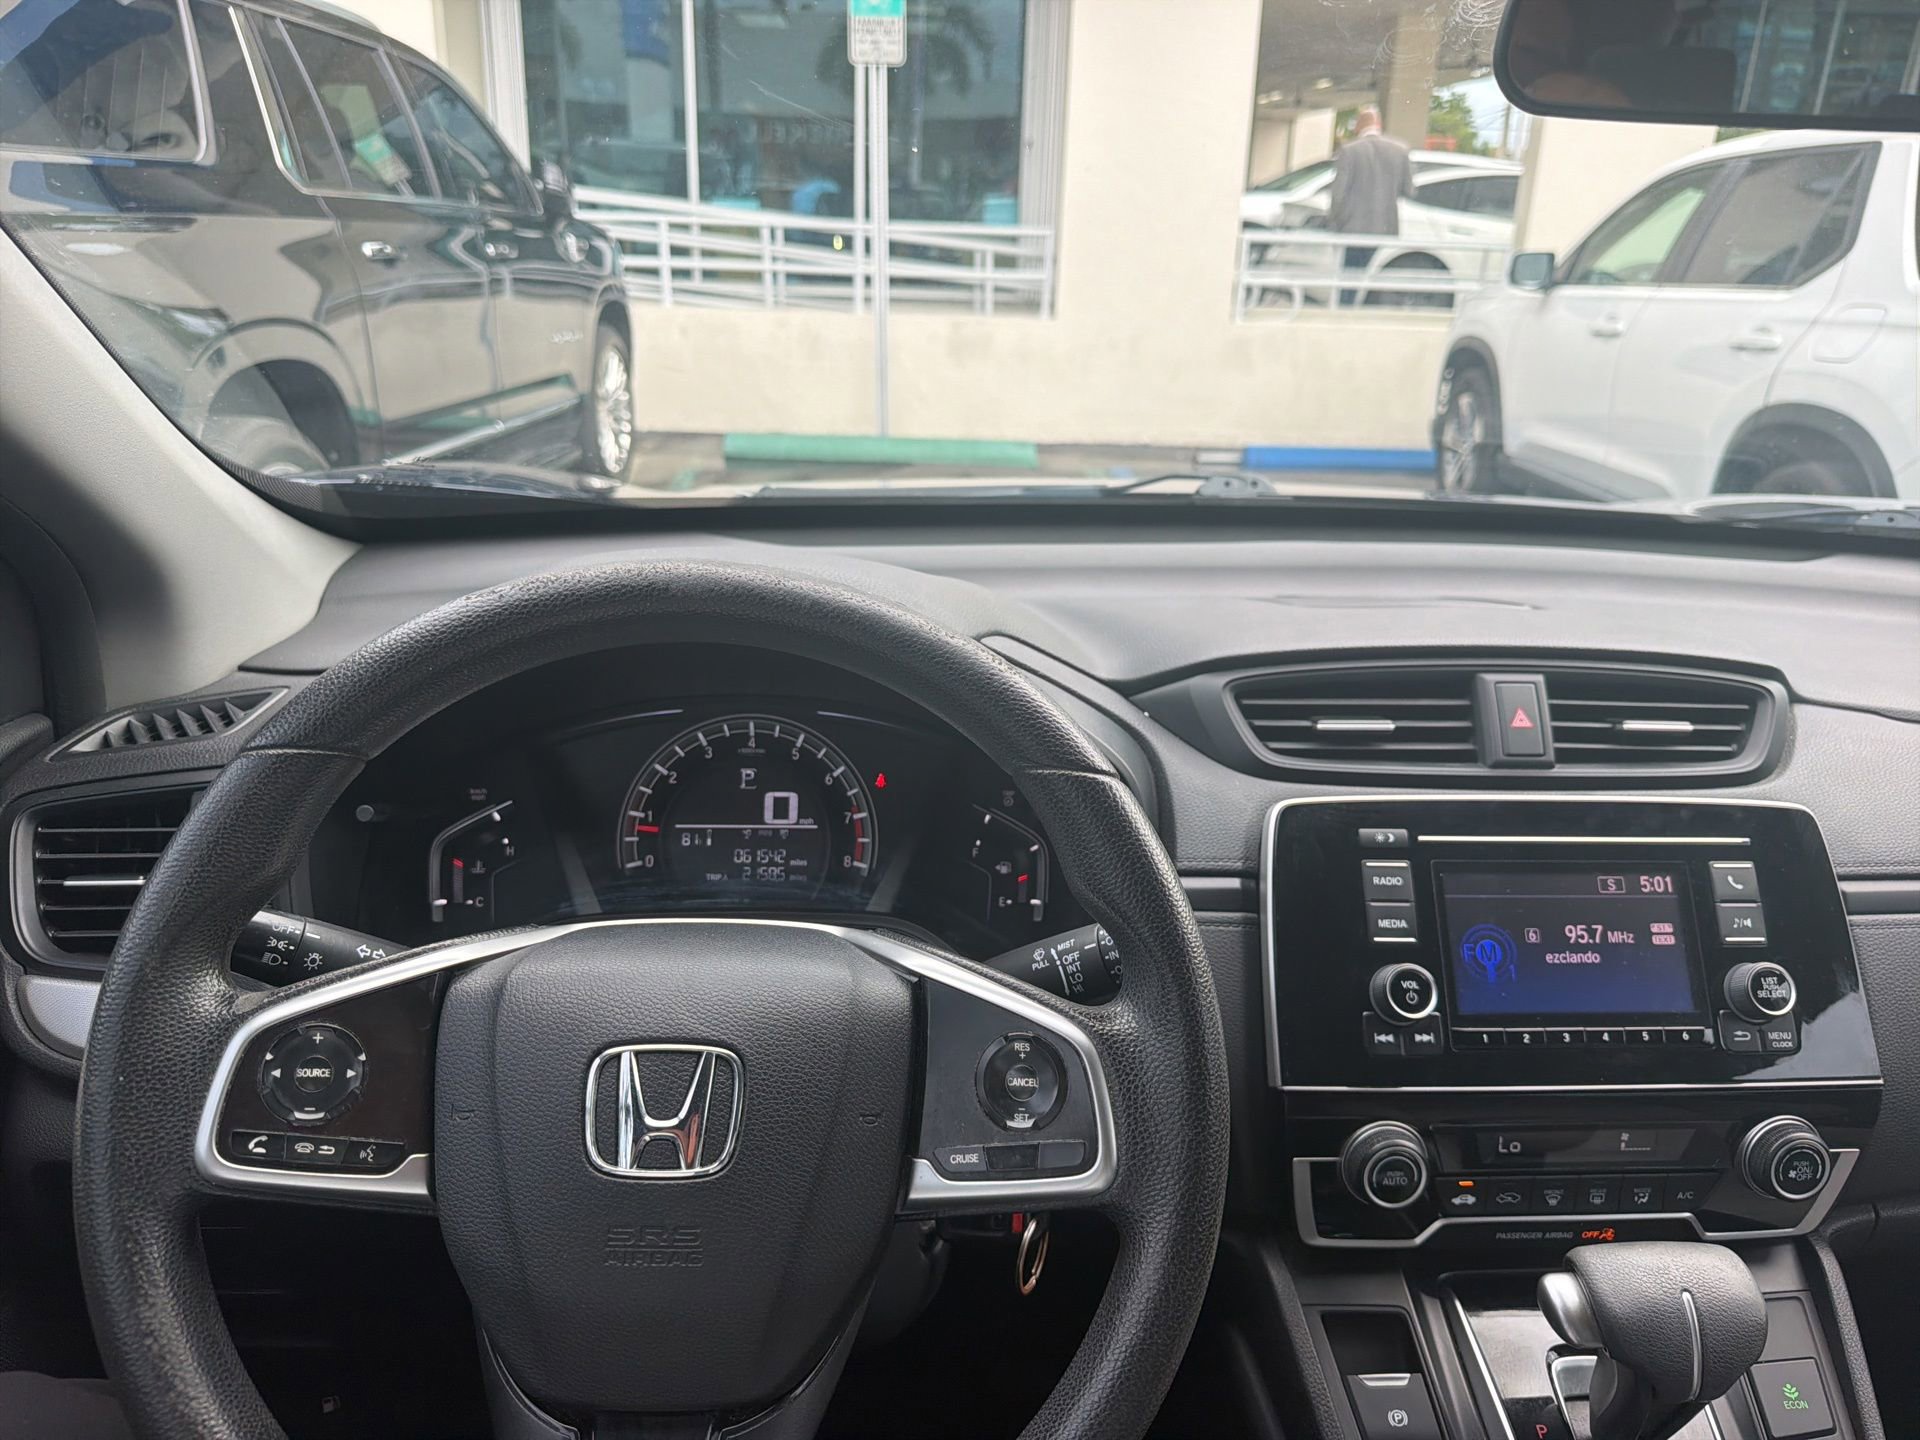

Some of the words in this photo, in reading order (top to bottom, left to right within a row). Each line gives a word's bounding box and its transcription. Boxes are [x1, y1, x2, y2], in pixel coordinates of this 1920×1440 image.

[748, 737, 756, 748] 4
[704, 747, 713, 759] 3
[791, 748, 800, 760] 5
[669, 772, 677, 784] 2
[824, 773, 833, 785] 6
[764, 792, 799, 824] 0
[647, 810, 653, 822] 1
[844, 812, 852, 824] 7
[506, 846, 515, 856] H
[972, 847, 979, 858] F
[645, 855, 654, 867] 0
[843, 856, 852, 867] 8
[1373, 876, 1402, 886] RADIO
[1607, 879, 1616, 889] S
[1640, 876, 1673, 893] 5:01
[475, 896, 484, 907] C
[999, 896, 1006, 907] E
[1378, 918, 1407, 929] MEDIA
[1564, 925, 1603, 944] 95.7
[1607, 931, 1635, 944] MHz
[1057, 938, 1076, 951] MIST
[1062, 951, 1081, 965] OFF
[1545, 951, 1600, 963] ezclando
[1031, 959, 1050, 971] PULL
[1066, 961, 1081, 974] INT
[1069, 972, 1083, 984] LO
[1073, 982, 1084, 993] HI
[1401, 980, 1419, 989] VOL
[1757, 990, 1786, 998] SELECT
[1483, 1034, 1489, 1043] 1
[1523, 1034, 1531, 1043] 2
[1563, 1033, 1570, 1042] 3
[1602, 1032, 1609, 1042] 4
[1642, 1031, 1649, 1041] 5
[1682, 1031, 1690, 1041] 6
[1768, 1032, 1791, 1040] MENU
[1014, 1043, 1030, 1052] RES
[296, 1067, 330, 1077] SOURCE
[1008, 1077, 1038, 1087] CANCEL
[1014, 1113, 1029, 1122] SET
[1499, 1136, 1521, 1153] Lo
[950, 1153, 979, 1164] CRUISE
[1382, 1177, 1408, 1186] AUTO
[1677, 1191, 1694, 1200] A/C
[607, 1227, 701, 1246] SRS
[1496, 1231, 1543, 1239] PASSENGER
[1544, 1231, 1573, 1239] AIRBAG
[1581, 1230, 1600, 1239] OFF
[603, 1250, 703, 1267] AIRBAG
[1784, 1400, 1808, 1410] ECON
[1535, 1424, 1548, 1439] P
